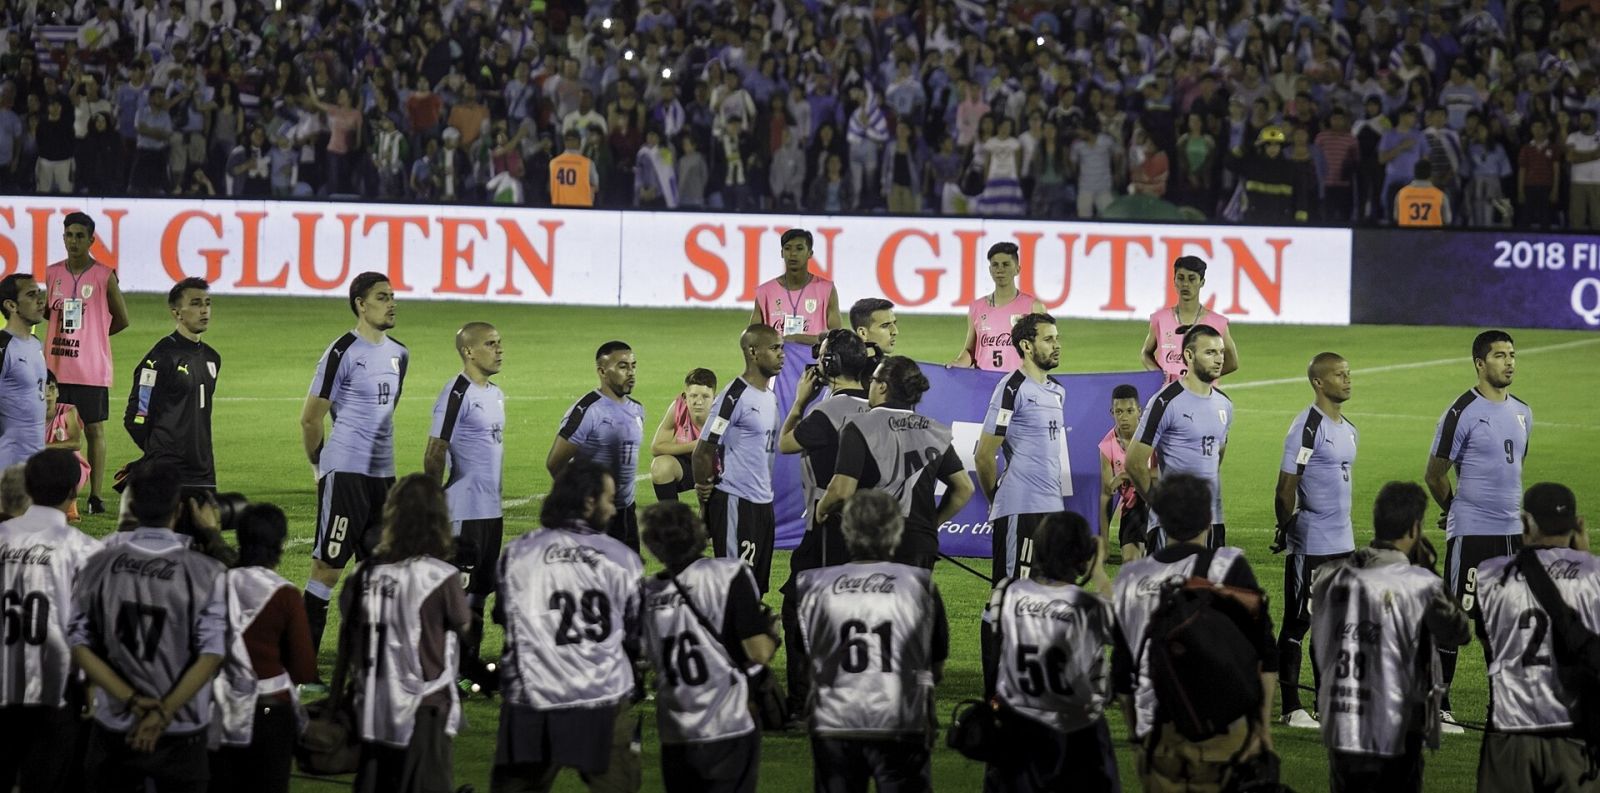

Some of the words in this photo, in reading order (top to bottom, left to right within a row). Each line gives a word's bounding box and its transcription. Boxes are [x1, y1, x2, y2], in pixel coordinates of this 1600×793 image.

[557, 167, 576, 185] 40
[1409, 202, 1432, 220] 37
[160, 209, 564, 297] GLUTEN
[1493, 240, 1566, 270] 2018
[1572, 243, 1600, 271] FI
[683, 223, 843, 302] SIN
[875, 228, 1292, 316] GLUTEN
[992, 350, 1003, 368] 5
[199, 383, 206, 409] 1
[1048, 419, 1058, 441] 11
[621, 440, 634, 465] 17
[1201, 435, 1215, 457] 13
[1503, 439, 1514, 464] 9
[1340, 460, 1349, 482] 5
[331, 514, 349, 541] 19
[937, 520, 970, 534] For
[971, 521, 994, 535] th
[1019, 537, 1034, 563] 11
[1465, 567, 1478, 592] 9
[2, 590, 49, 646] 60
[549, 588, 612, 646] 29
[841, 618, 893, 673] 61
